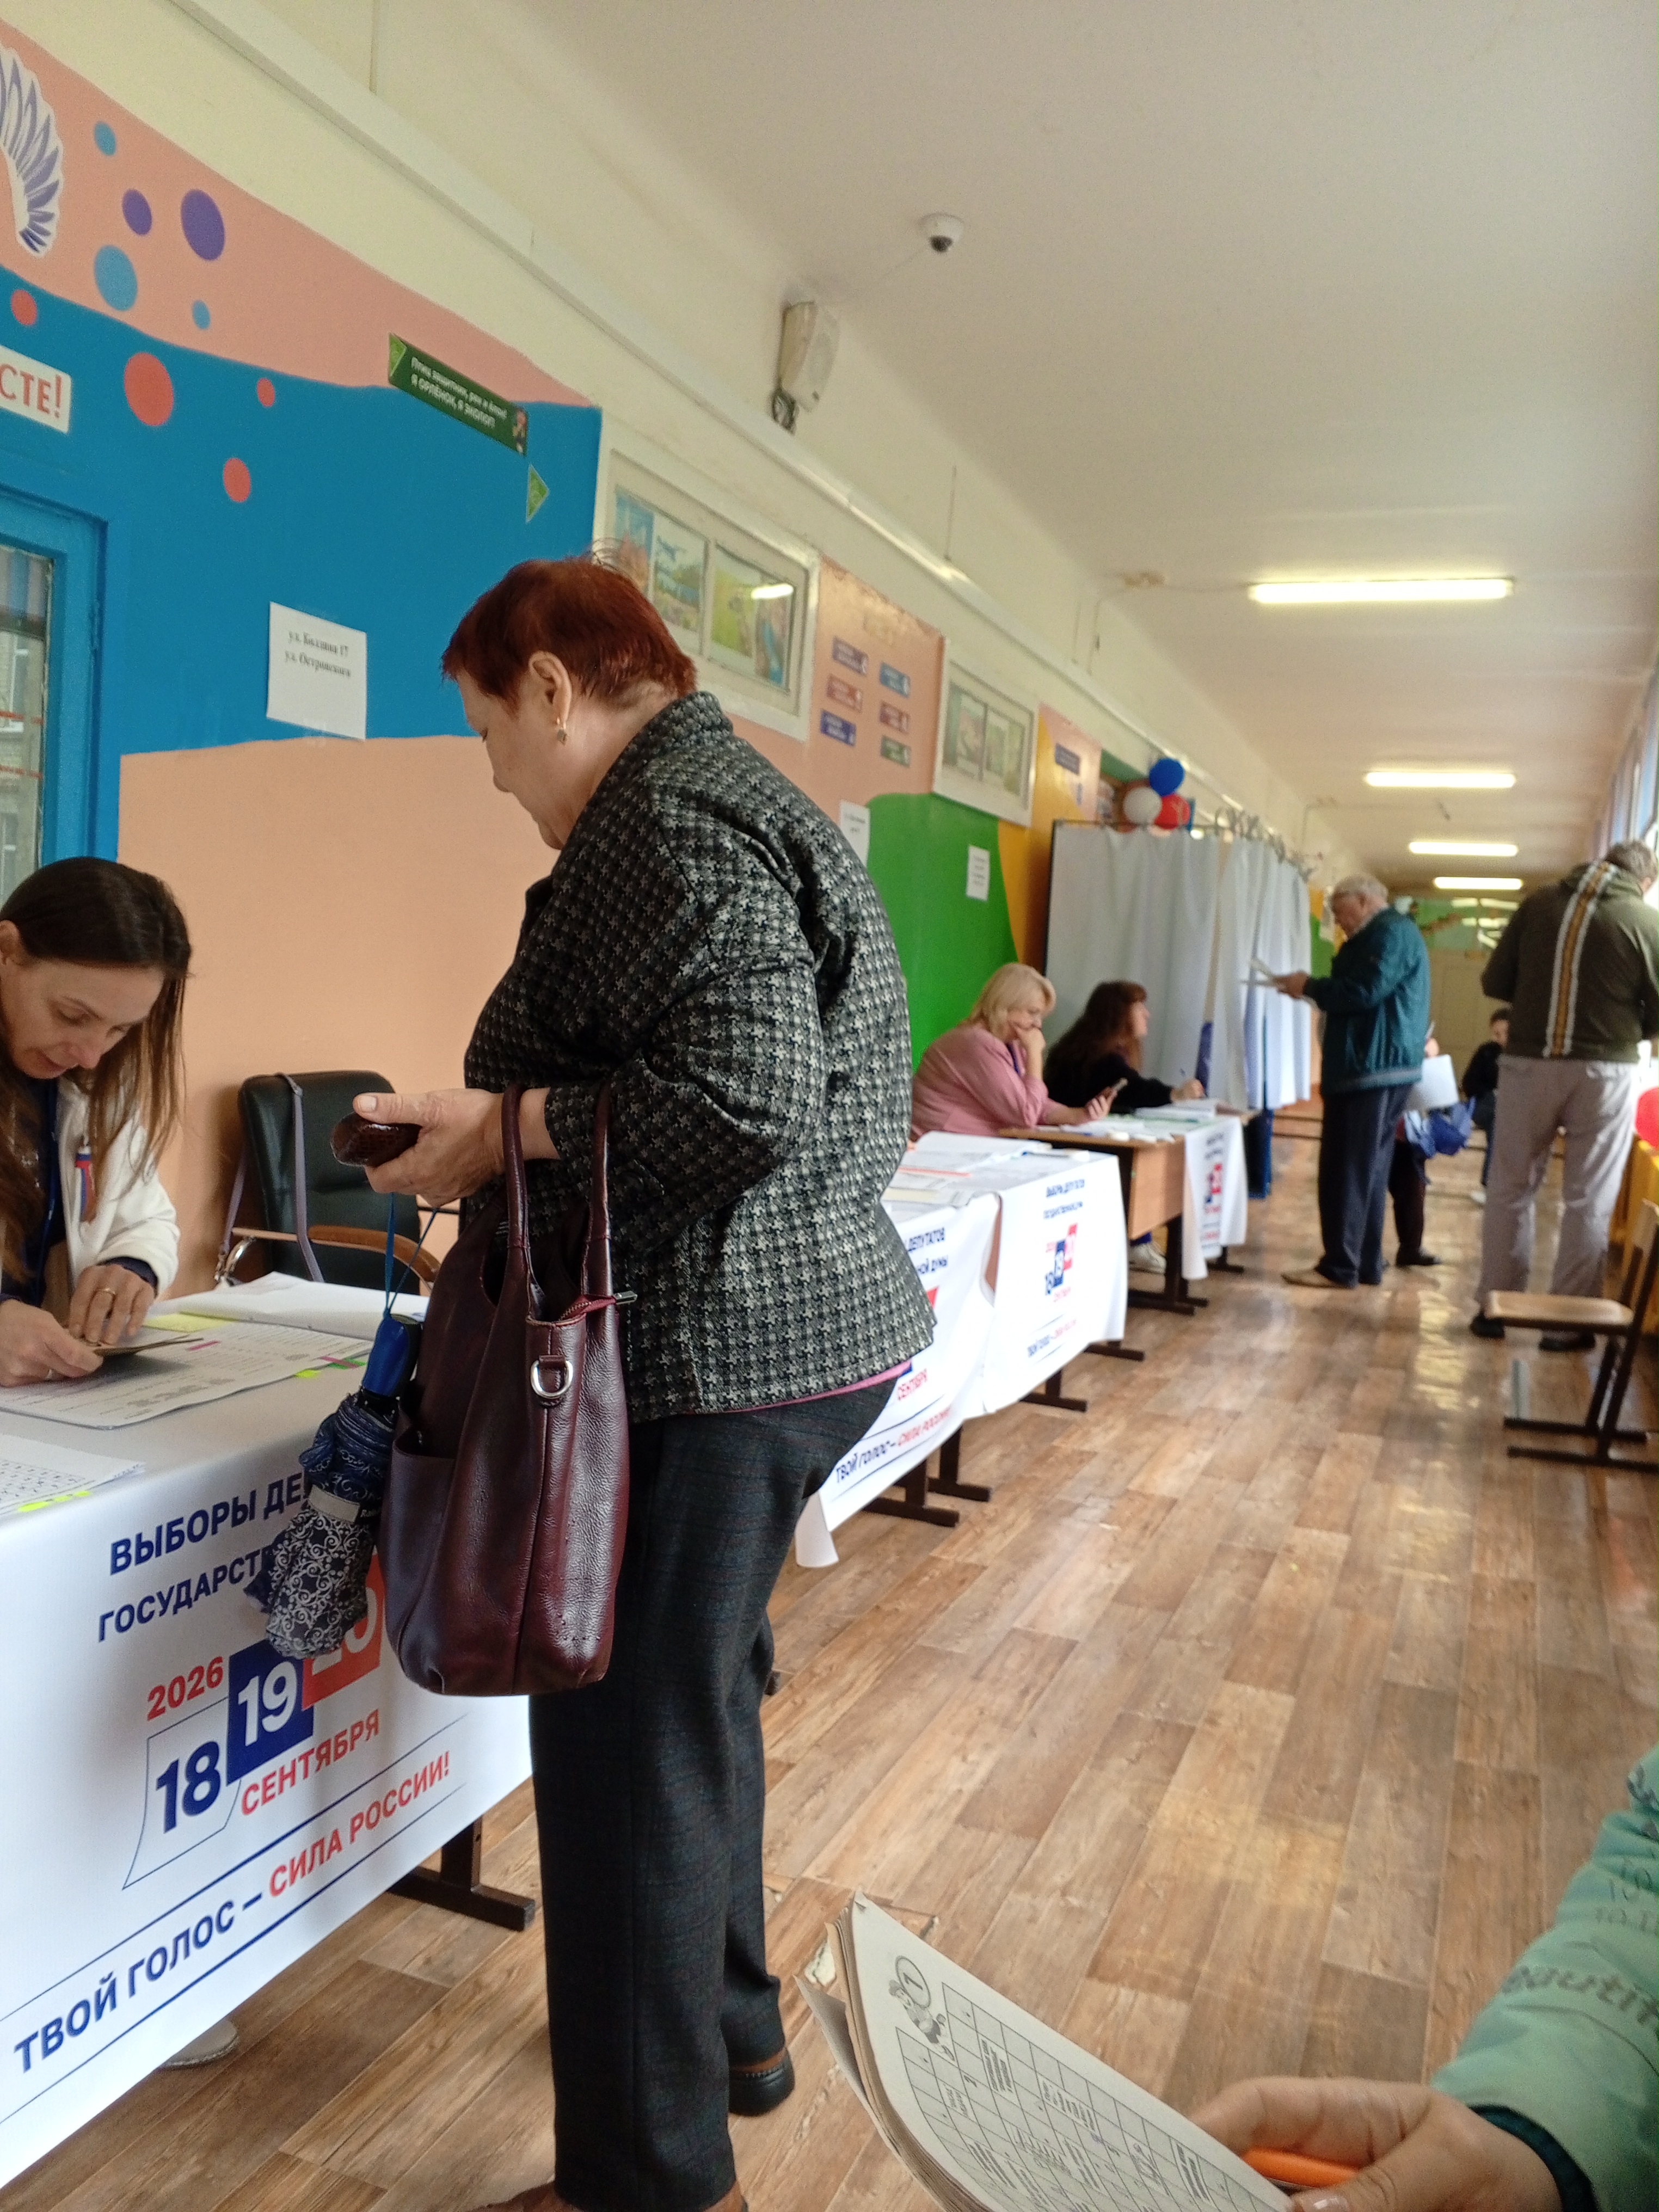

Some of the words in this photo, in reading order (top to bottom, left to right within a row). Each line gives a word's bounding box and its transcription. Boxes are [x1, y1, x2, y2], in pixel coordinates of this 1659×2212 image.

[0, 364, 62, 419] СТЕ!
[907, 1227, 945, 1253] ДЕПУТАТОВ
[836, 1452, 858, 1483] ТВОЙ
[110, 1489, 257, 1576] ВЫБОРЫ
[263, 1472, 305, 1520] ДЕ
[99, 1549, 265, 1643] ГОСУДАРСТ
[147, 1656, 224, 1722] 2026
[156, 1741, 221, 1834] 18
[237, 1660, 298, 1747] 19
[241, 1709, 379, 1816] СЕНТЯБРЯ
[13, 1971, 117, 2074] ТВОЙ
[127, 1900, 235, 1999] ГОЛОС
[269, 1828, 343, 1897] СИЛА
[349, 1750, 450, 1845] РОССИИ!
